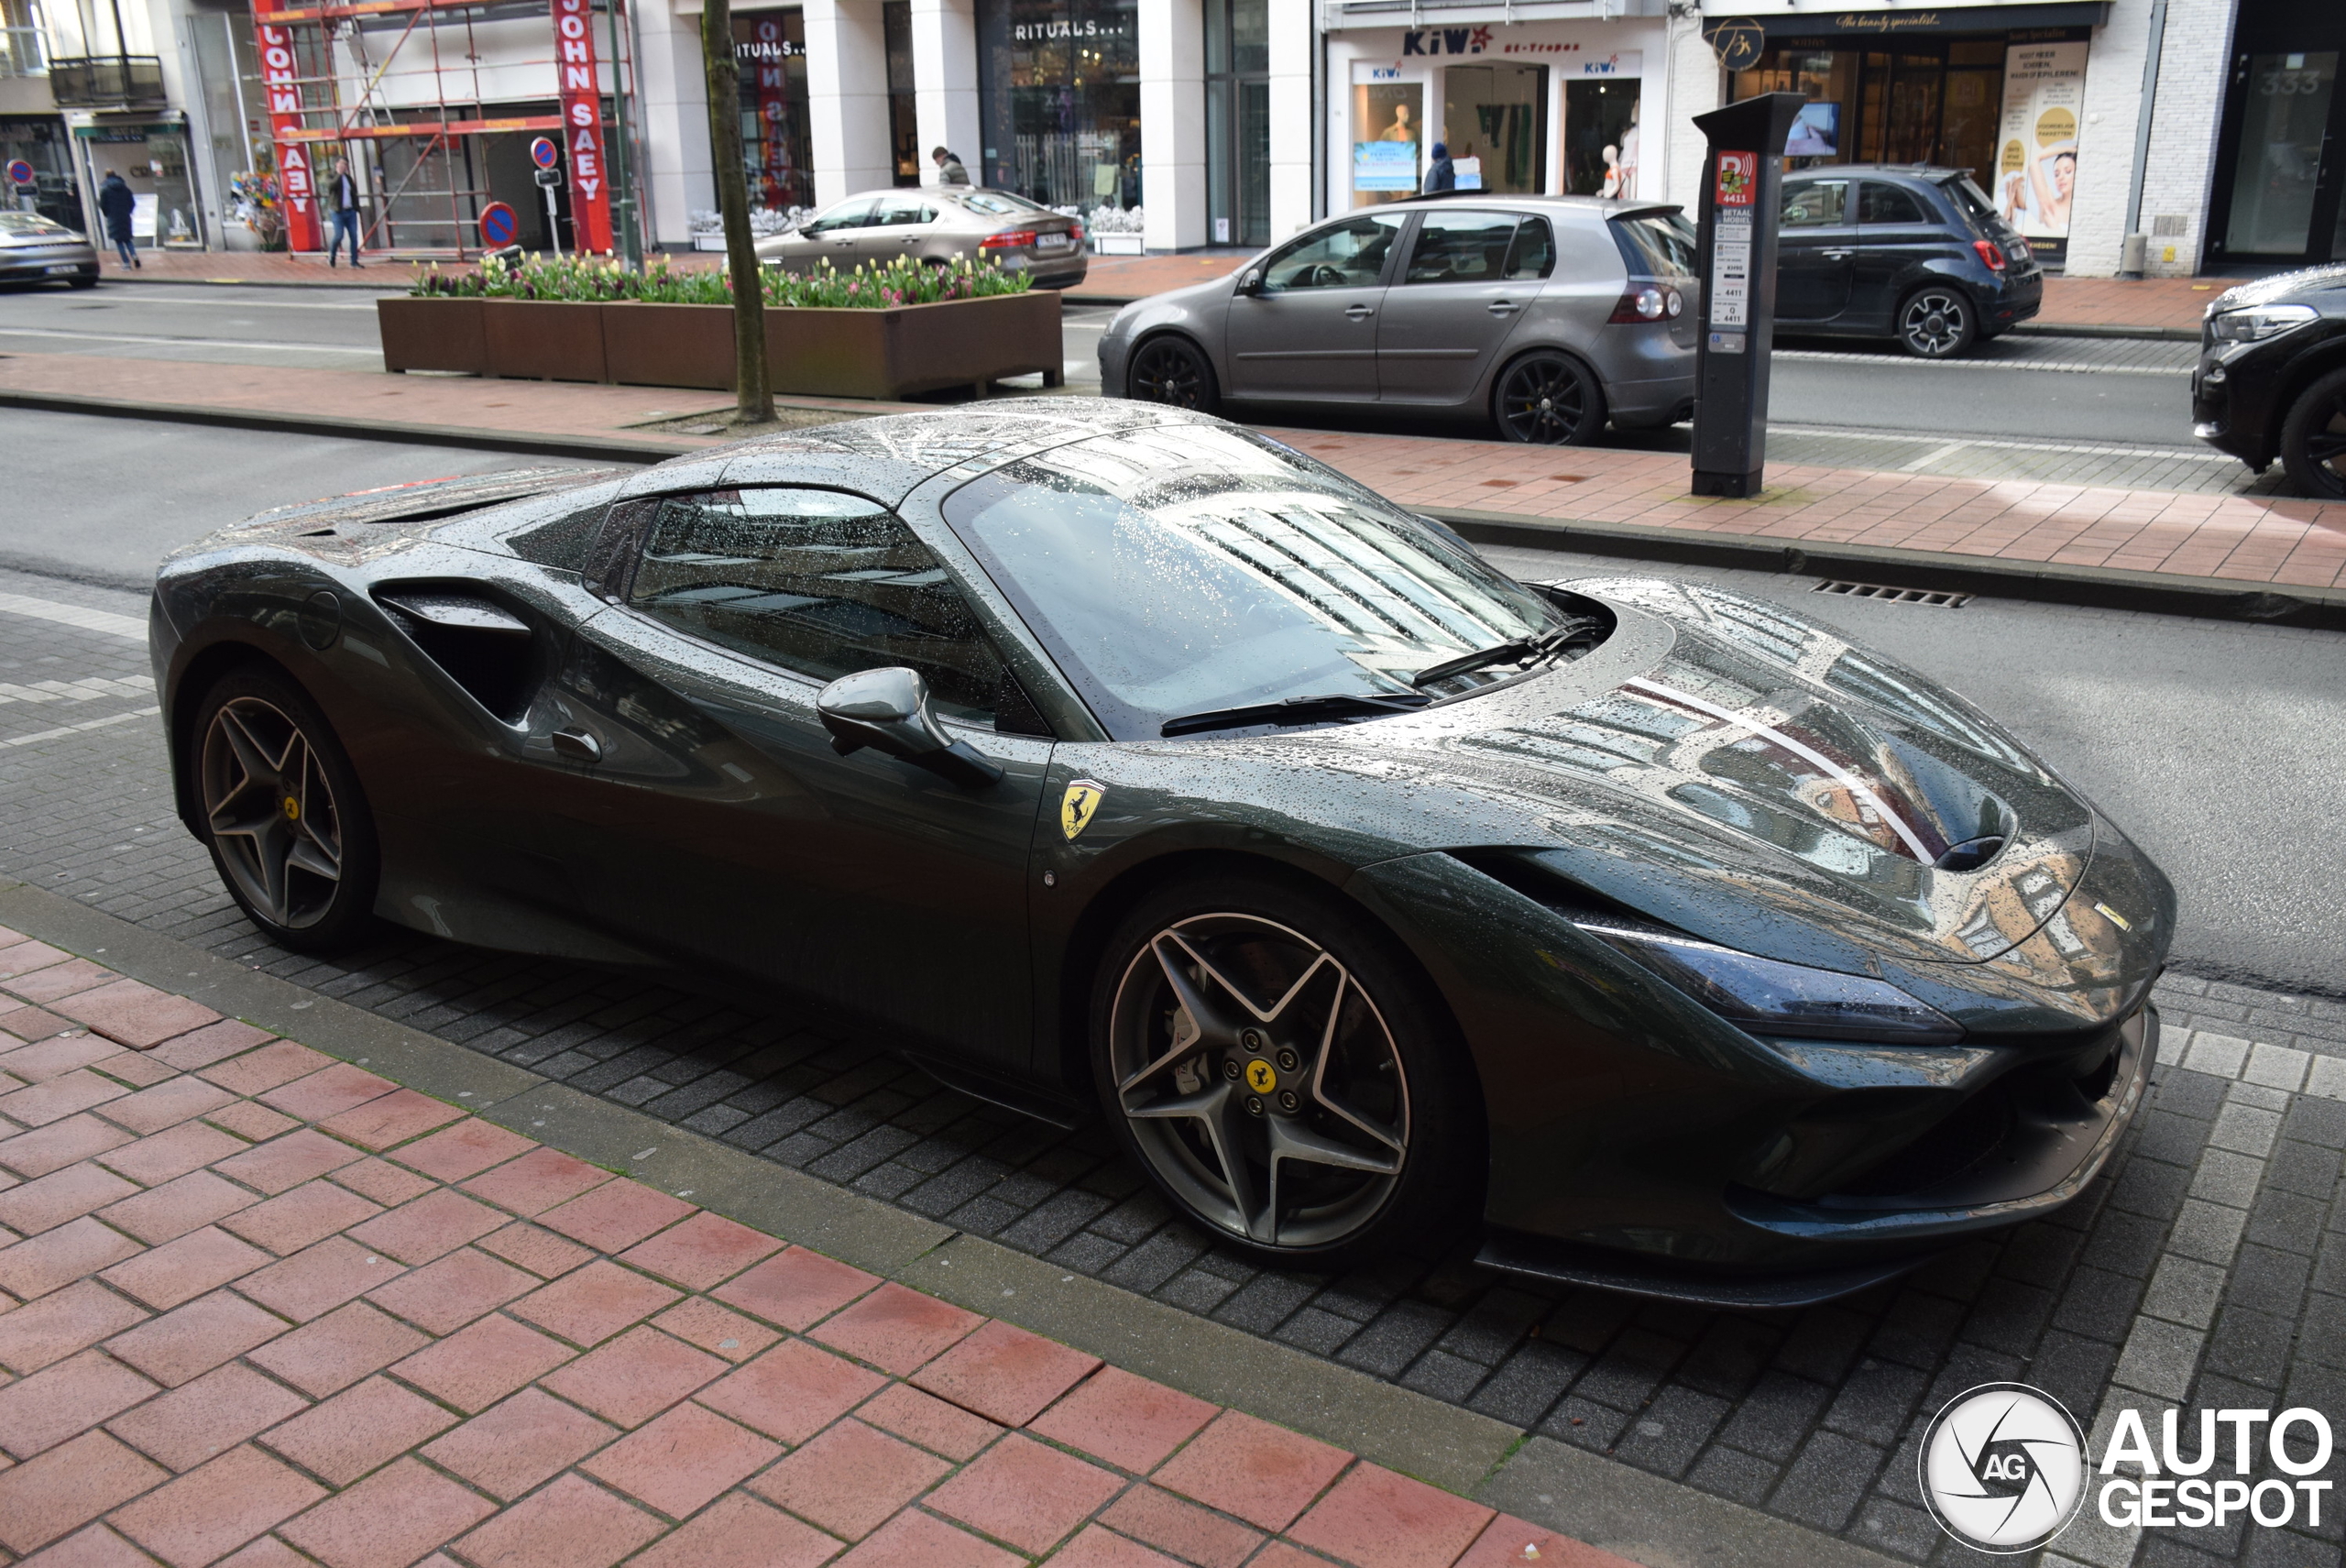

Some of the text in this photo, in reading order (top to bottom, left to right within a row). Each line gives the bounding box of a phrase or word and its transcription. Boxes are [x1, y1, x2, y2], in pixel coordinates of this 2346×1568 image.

[1857, 15, 1889, 33] beauty
[2260, 71, 2320, 95] 333
[572, 104, 600, 201] SAEY
[1723, 193, 1747, 203] 4411
[1723, 208, 1751, 217] BETAAL
[1725, 289, 1742, 297] 4411
